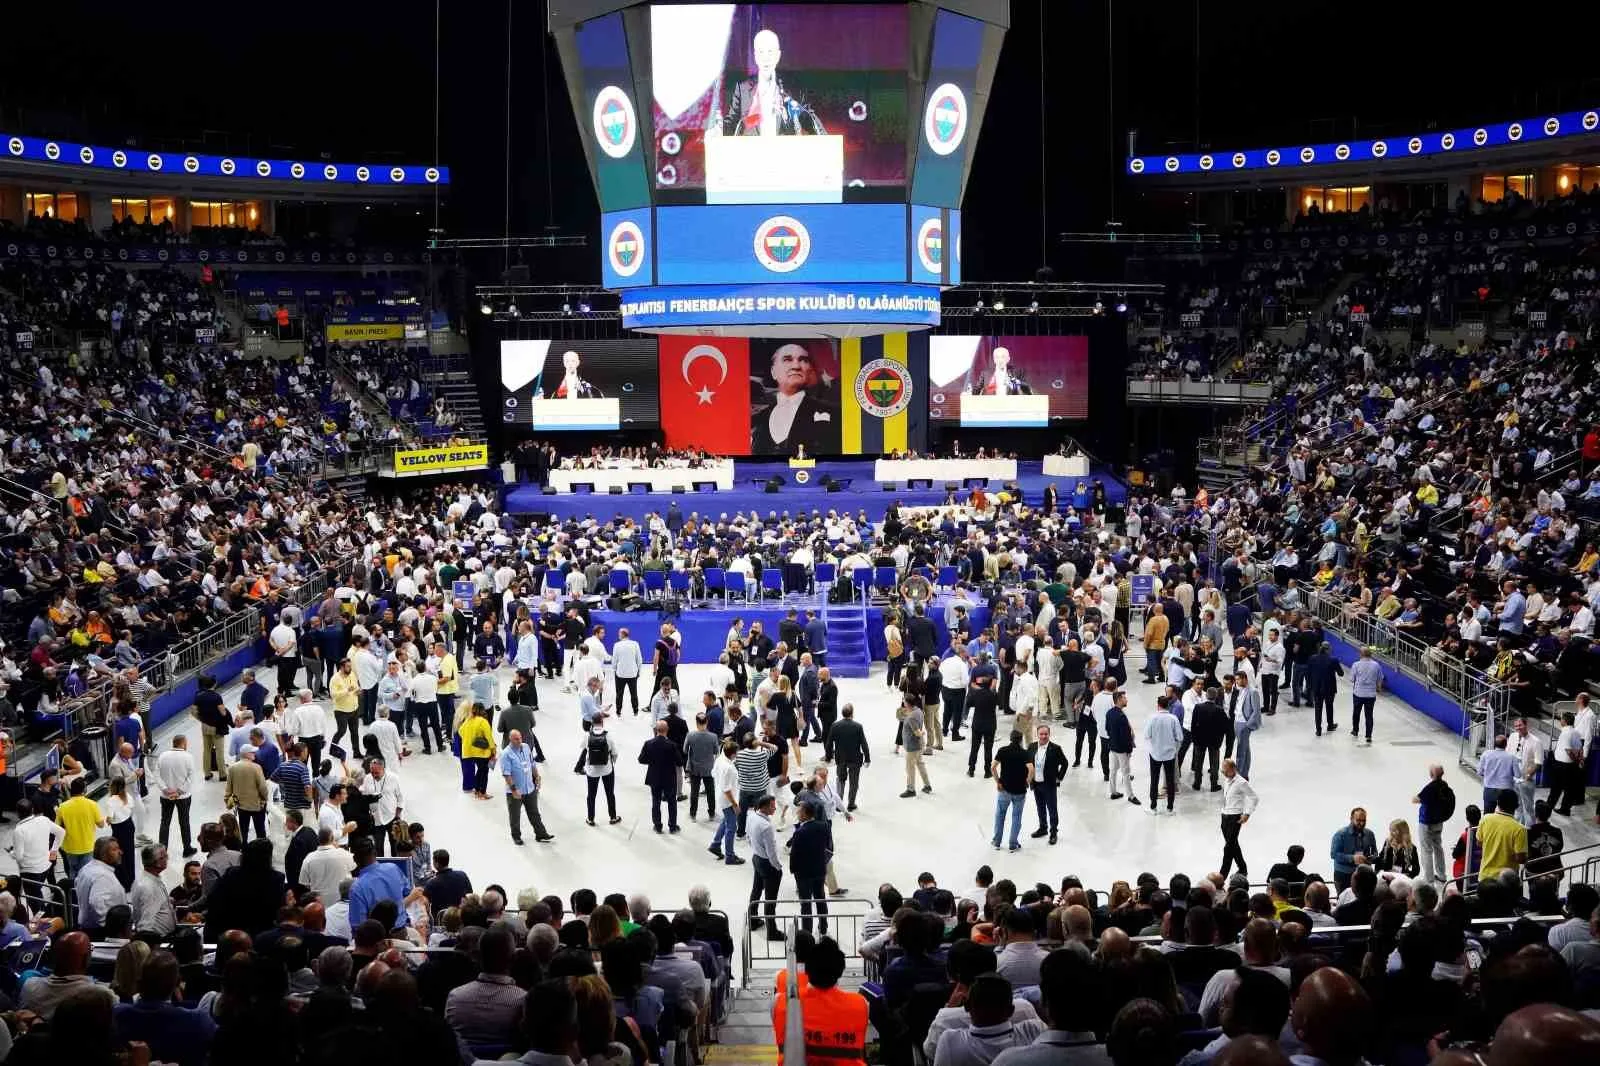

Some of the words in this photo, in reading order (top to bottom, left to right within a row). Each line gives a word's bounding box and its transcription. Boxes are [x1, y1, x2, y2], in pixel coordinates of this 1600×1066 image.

[670, 298, 754, 313] FENERBAHÇE
[756, 297, 796, 311] SPOR
[799, 294, 855, 311] KULÜBÜ
[401, 454, 447, 466] YELLOW
[449, 451, 482, 462] SEATS
